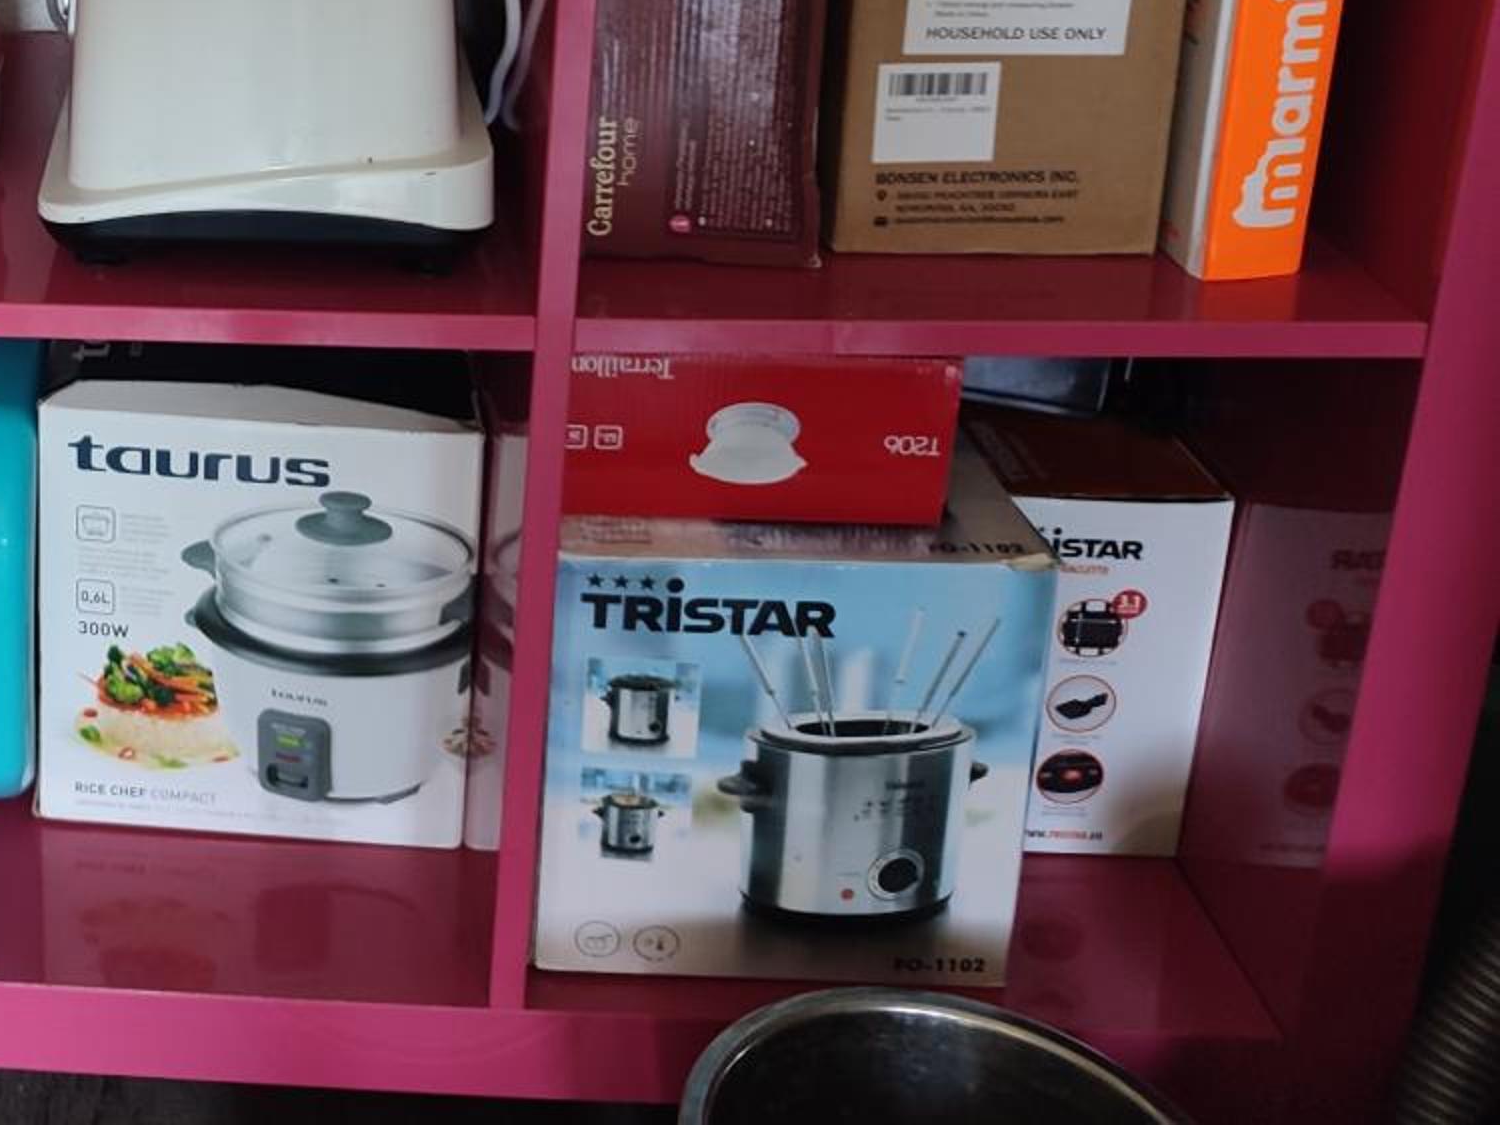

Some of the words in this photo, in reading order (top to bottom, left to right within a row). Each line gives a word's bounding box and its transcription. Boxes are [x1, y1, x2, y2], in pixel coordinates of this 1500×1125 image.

[926, 27, 1025, 41] HOUSEHOLD
[1029, 27, 1060, 40] USE
[1064, 27, 1107, 41] ONLY
[616, 116, 640, 187] home
[586, 115, 618, 237] Carrefour
[875, 172, 938, 186] BONSEN
[942, 171, 1046, 185] ELECTRONICS
[571, 354, 676, 380] Terraillon
[883, 435, 942, 457] T206
[67, 434, 331, 488] taurus
[78, 620, 129, 638] 300W
[74, 780, 107, 796] RICE
[110, 783, 148, 799] CHEF
[150, 787, 219, 805] COMPACT
